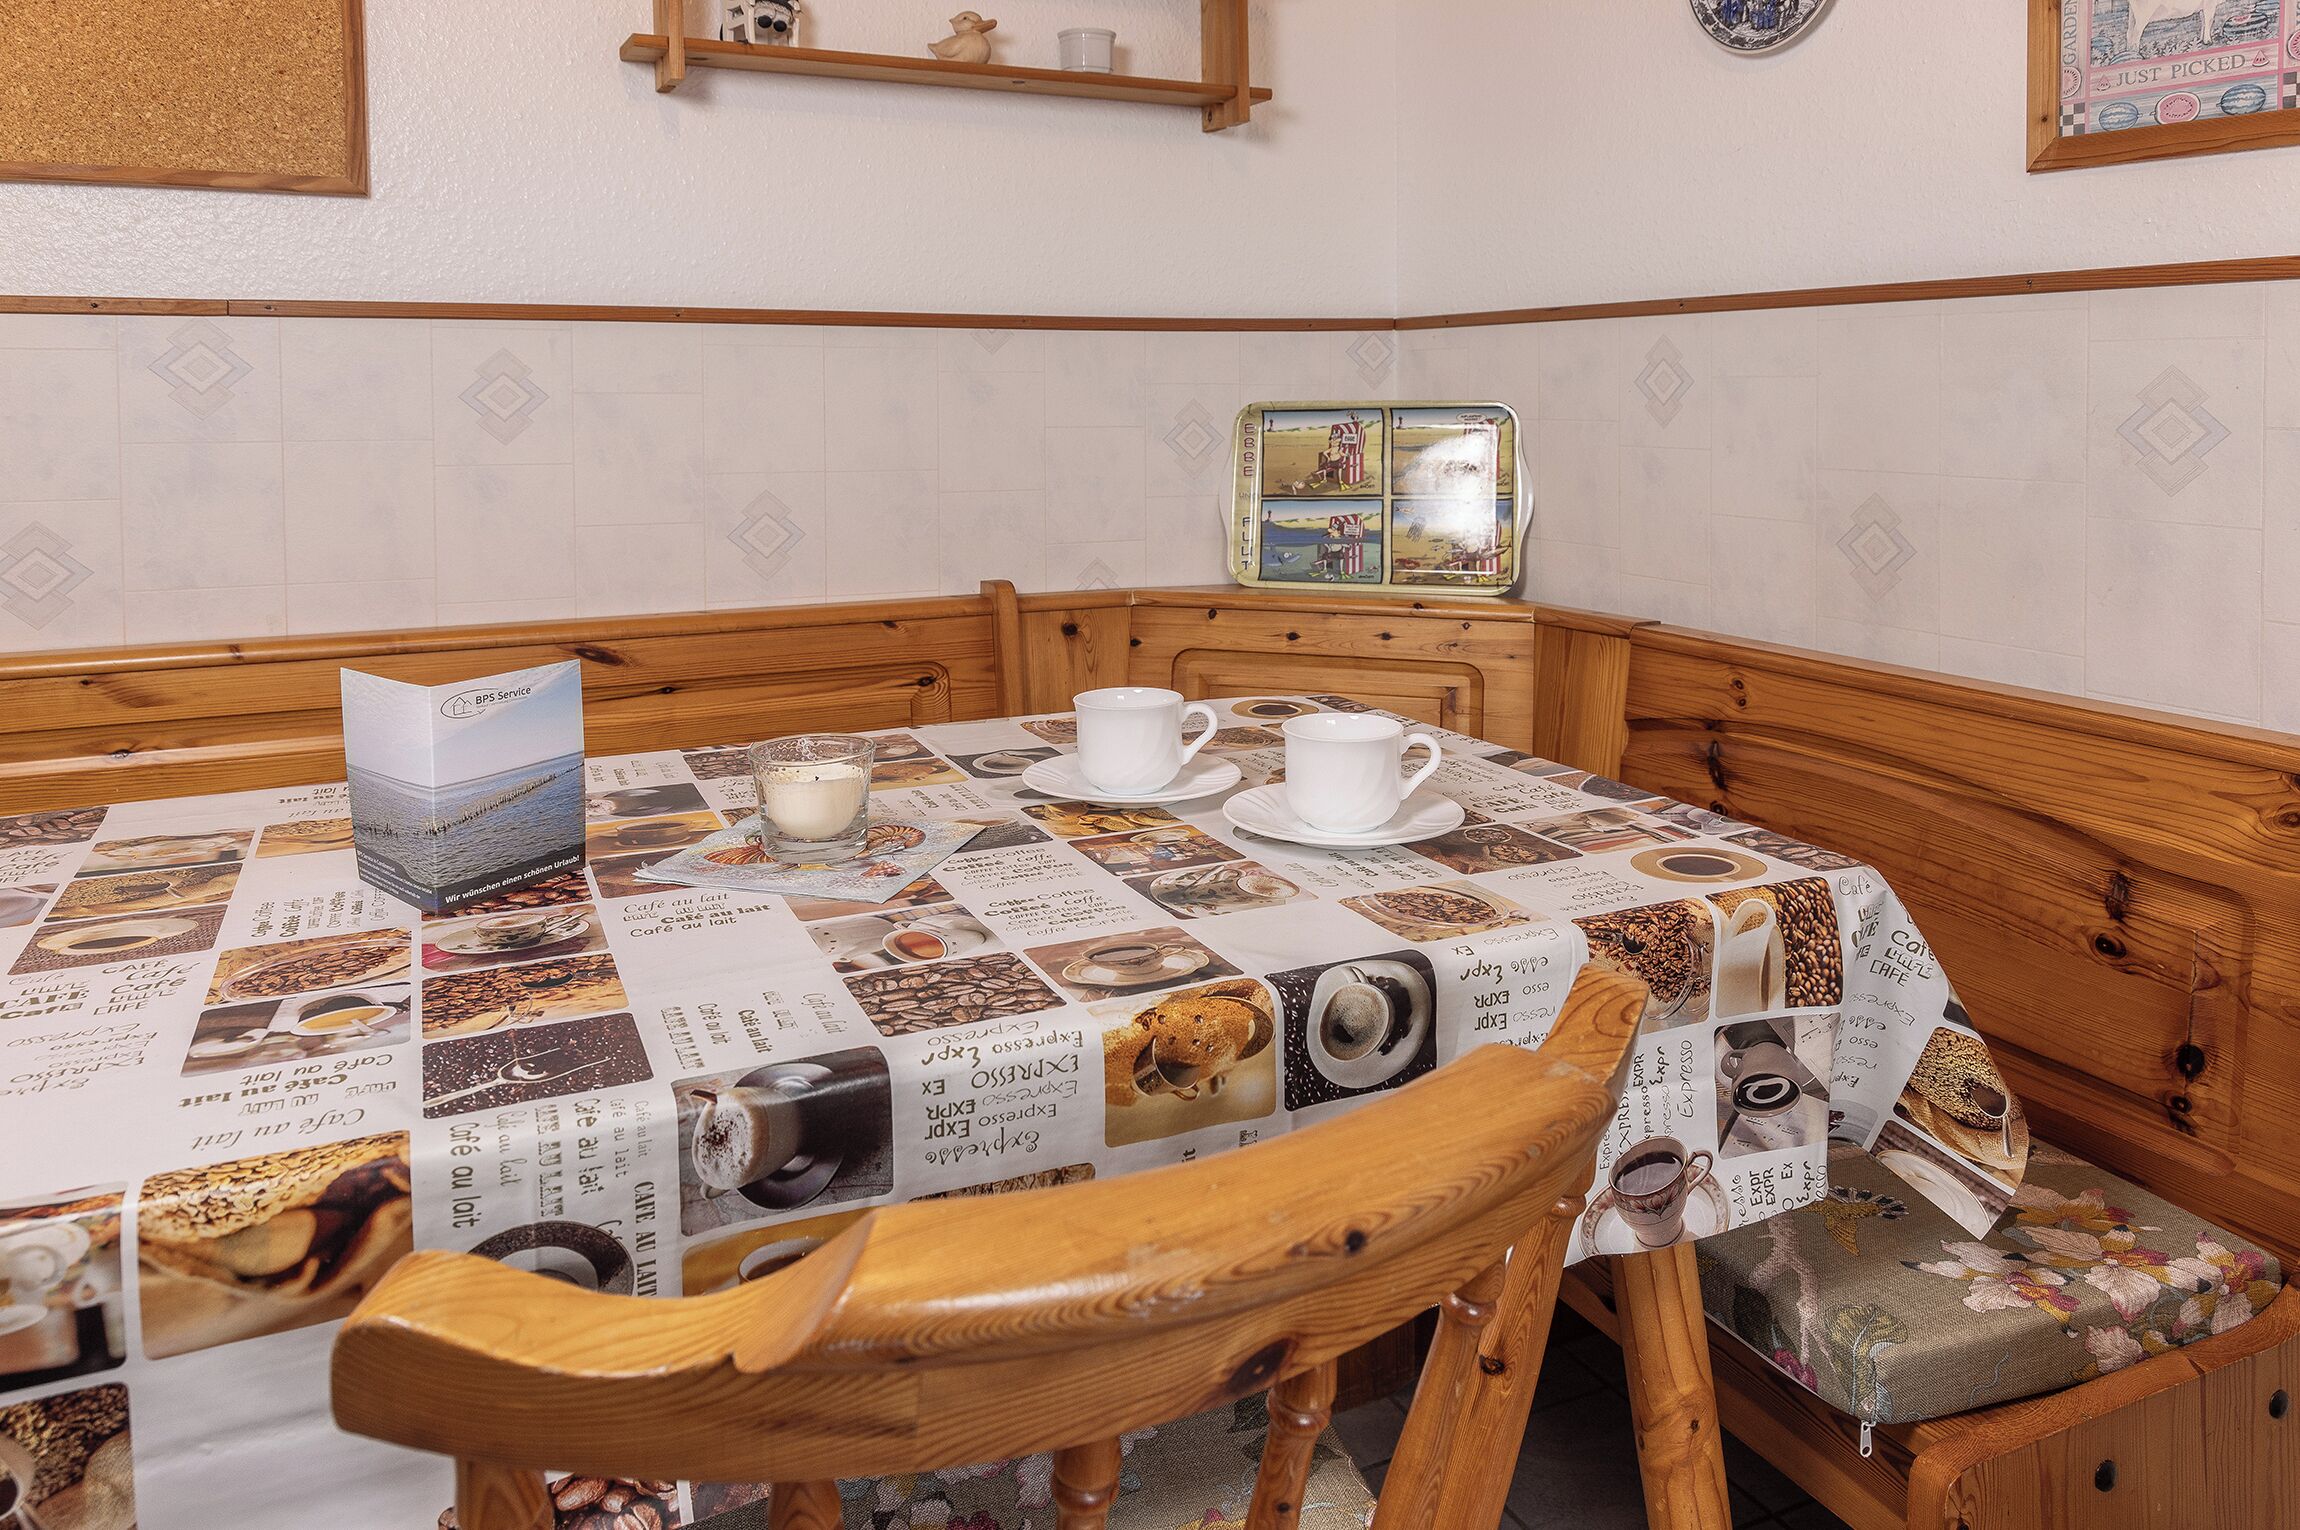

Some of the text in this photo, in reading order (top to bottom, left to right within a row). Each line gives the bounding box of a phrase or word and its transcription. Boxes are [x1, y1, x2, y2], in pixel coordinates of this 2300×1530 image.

[2116, 54, 2246, 87] JUST PICKED
[1243, 423, 1255, 477] EBBE
[475, 693, 495, 705] BPS
[497, 687, 531, 700] Service
[445, 854, 580, 904] Wir wünschen einen schönen Urlaub!
[1508, 865, 1581, 881] Expresso
[1839, 875, 1872, 896] Café
[624, 893, 731, 914] Café au lait
[661, 904, 772, 924] Café au lait
[630, 917, 737, 938] Café au lait
[1482, 928, 1560, 946] Expresso
[1451, 945, 1475, 957] Ex
[111, 977, 187, 994] Café
[1459, 957, 1549, 985] esso Expr
[1870, 960, 1911, 988] CAFÉ
[1474, 982, 1550, 1008] esso EXPR
[697, 1003, 731, 1045] Café au lait
[801, 993, 849, 1035] Café au lait
[1474, 1012, 1507, 1032] Expr
[7, 1023, 140, 1048] Expresso
[738, 1009, 773, 1054] Café au lait
[927, 1020, 1040, 1046] Expresso
[1849, 1036, 1879, 1049] esso
[921, 1029, 1083, 1069] Expresso Expr
[10, 1057, 145, 1083] EXPRESSO
[240, 1054, 393, 1086] Café au lait
[922, 1053, 1079, 1096] EXPRESSO Ex
[1632, 1053, 1645, 1087] EXPR
[1648, 1046, 1670, 1086] Expr
[1676, 1040, 1698, 1118] Expresso
[177, 1074, 348, 1109] Café au lait
[926, 1080, 1078, 1121] Expresso EXPR
[191, 1108, 365, 1153] Café au lait
[614, 1127, 626, 1142] au
[635, 1100, 652, 1158] Café au lait
[924, 1103, 1057, 1142] Expresso Expr
[499, 1134, 515, 1154] au
[924, 1126, 1040, 1166] Expresso
[450, 1122, 482, 1228] Café au lait
[498, 1158, 528, 1187] lait
[614, 1150, 630, 1179] lait
[1780, 1162, 1793, 1180] Ex
[1749, 1170, 1763, 1207] Expr
[1763, 1167, 1777, 1206] EXPR
[1796, 1161, 1815, 1203] Expr
[634, 1181, 658, 1297] CAFE AU LAIT
